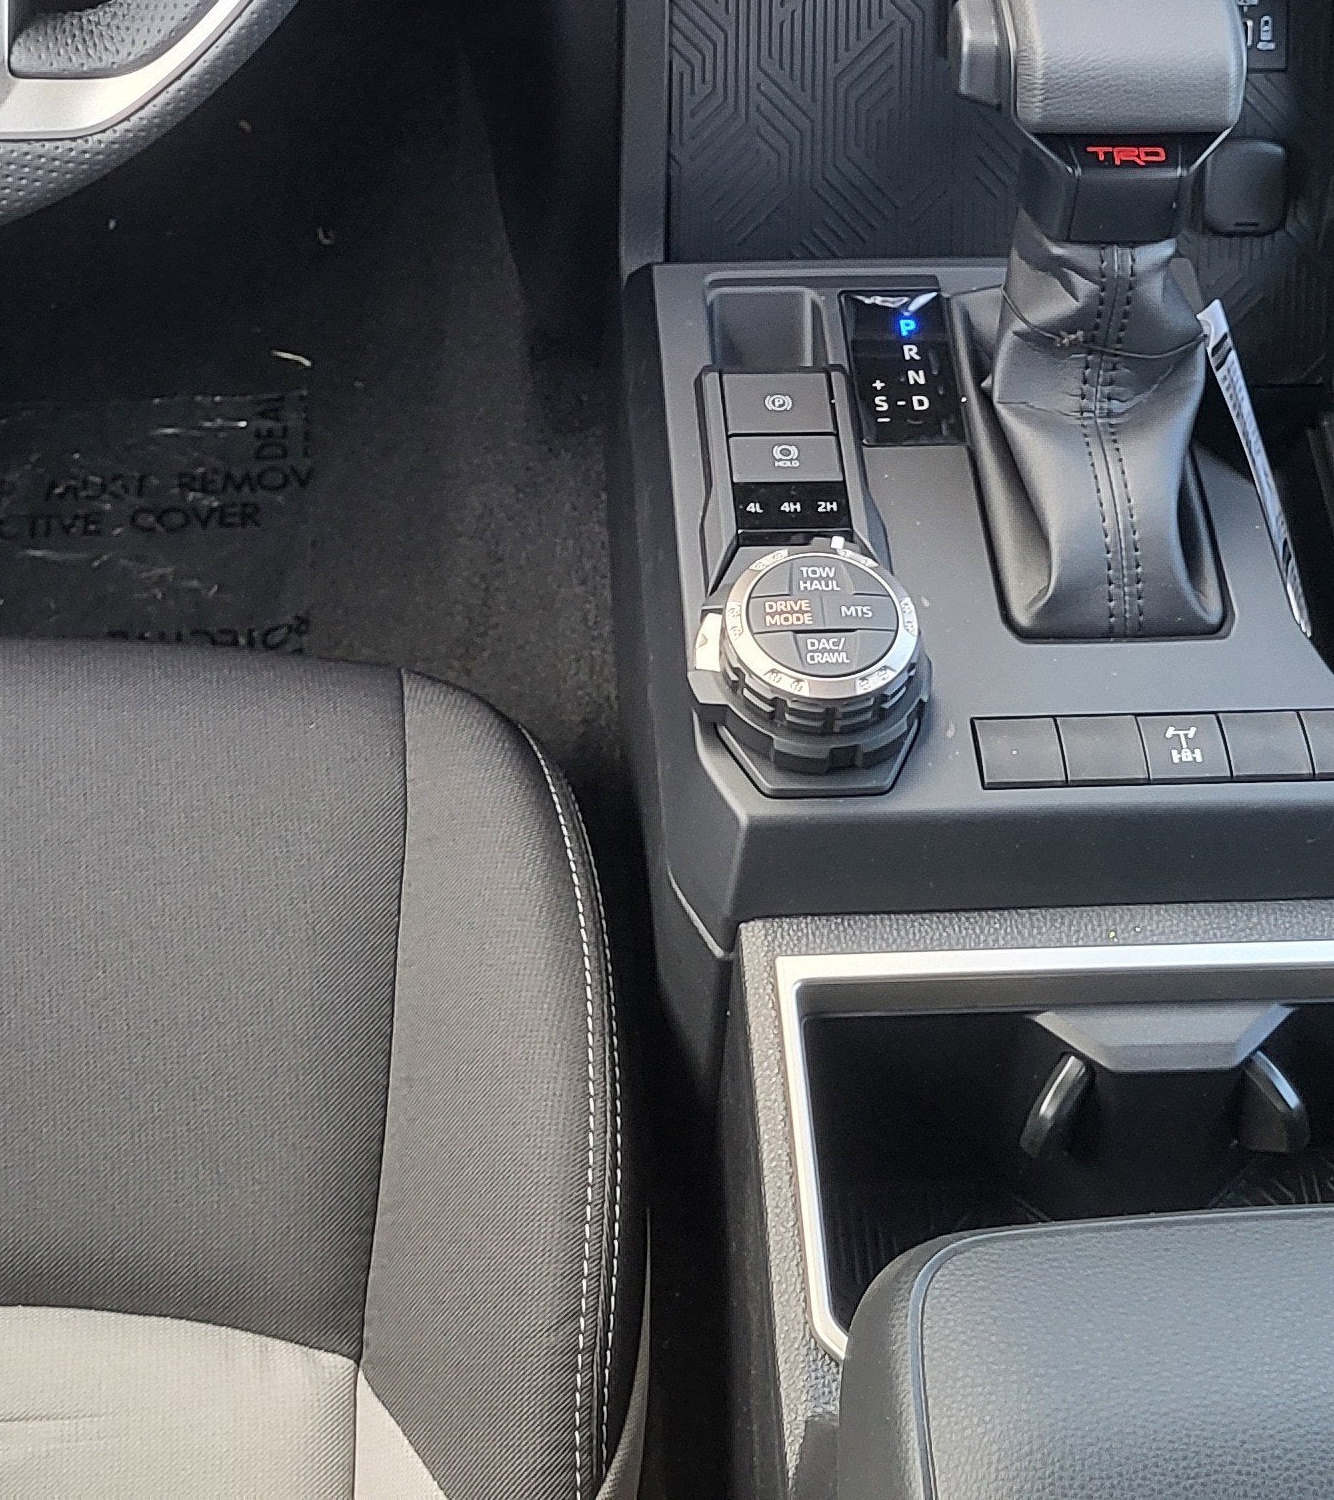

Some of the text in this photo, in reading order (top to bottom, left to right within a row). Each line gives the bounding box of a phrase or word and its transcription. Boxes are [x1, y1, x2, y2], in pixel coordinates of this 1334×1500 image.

[1086, 146, 1166, 166] TRD
[899, 318, 917, 337] P
[902, 344, 922, 361] R
[907, 369, 926, 386] N
[745, 501, 838, 514] 4L 4H 2H
[129, 501, 262, 534] COVER
[799, 566, 835, 579] TOW
[799, 579, 841, 592] HAUL
[764, 599, 812, 613] DRIVE
[840, 605, 873, 619] MTS
[764, 612, 814, 626] MODE
[806, 636, 845, 651] DAC/
[806, 652, 850, 665] CRAWL
